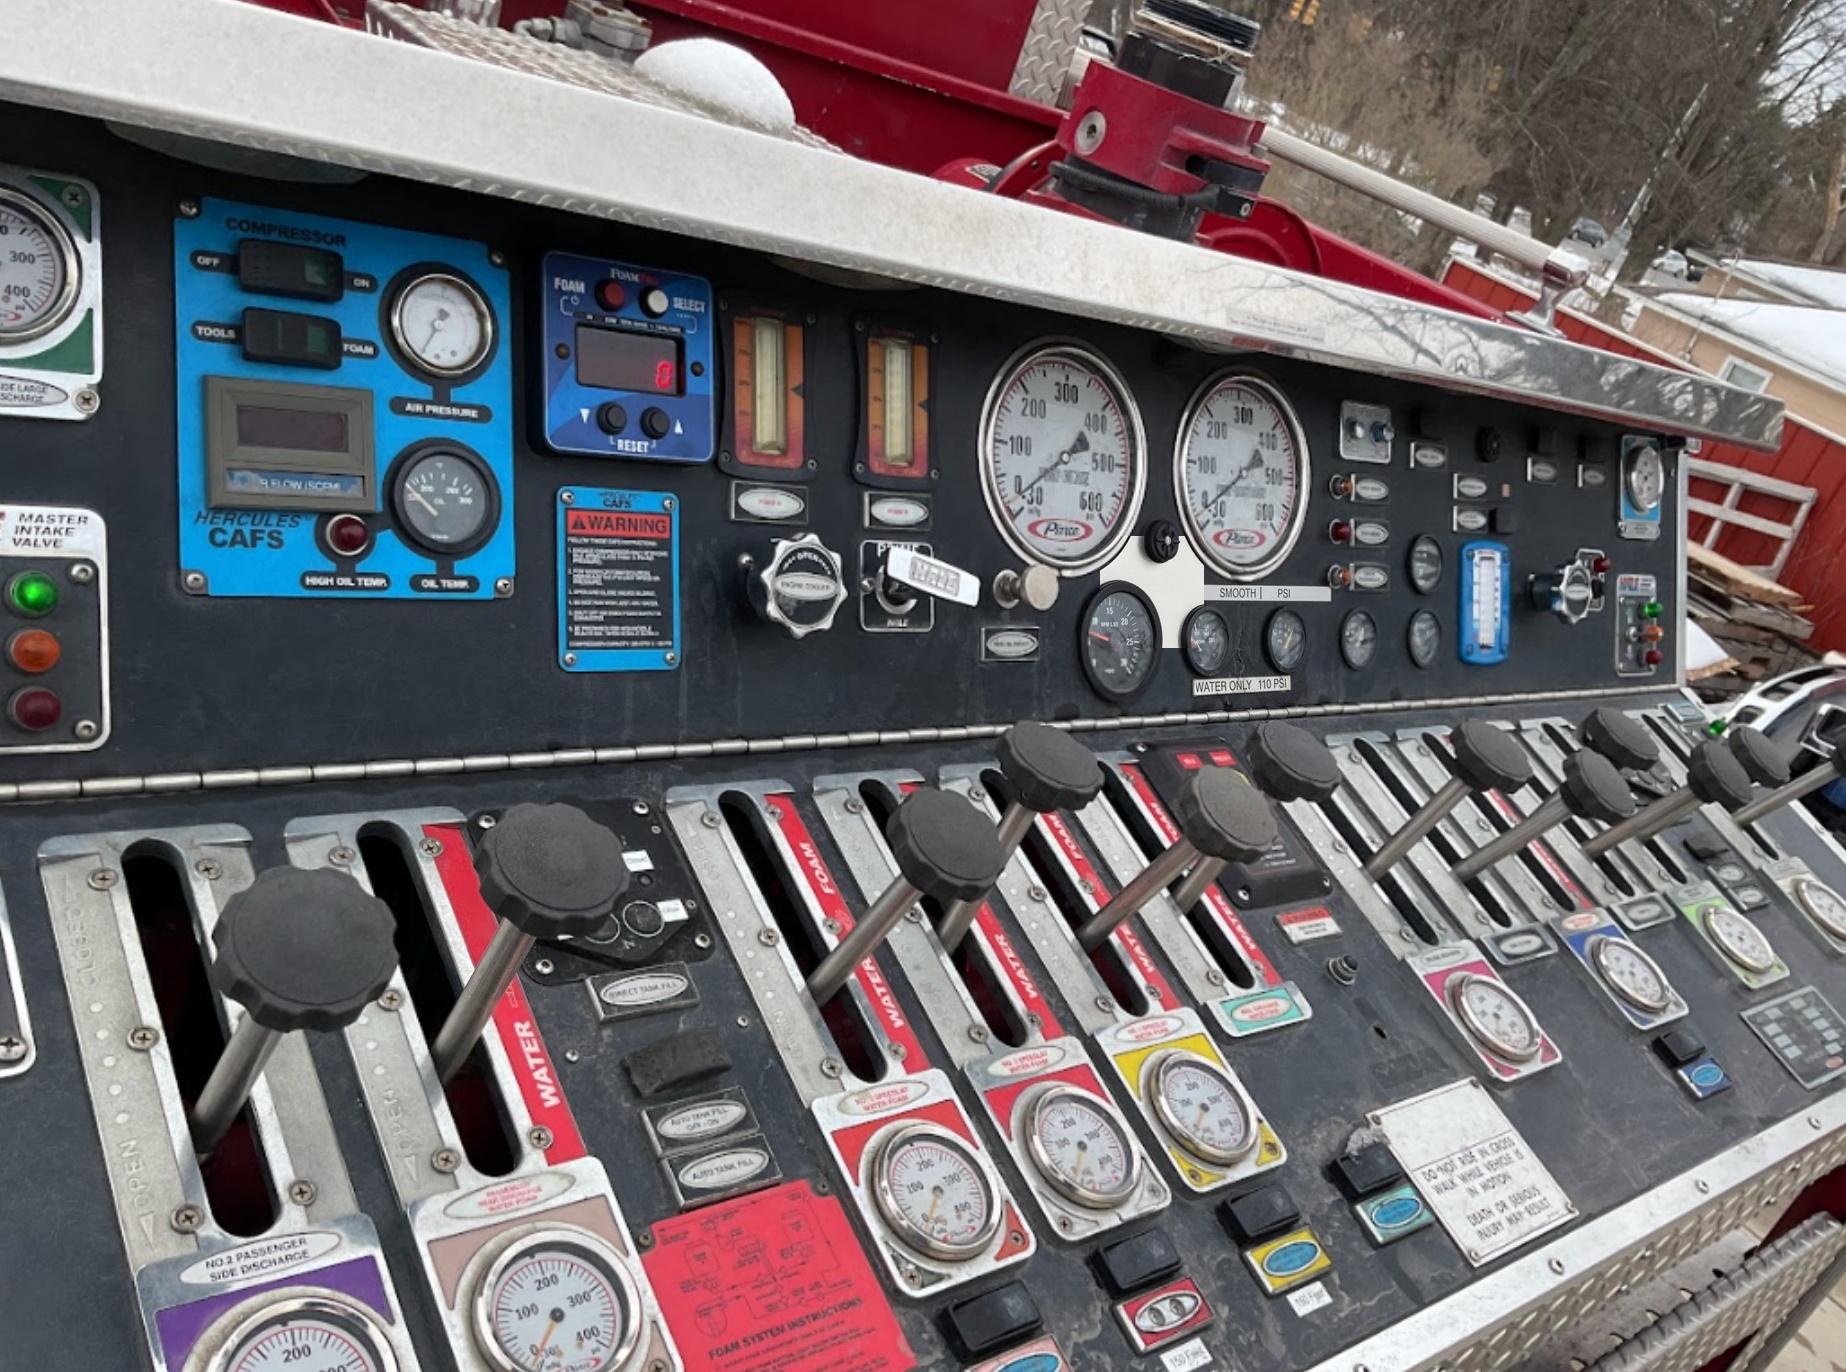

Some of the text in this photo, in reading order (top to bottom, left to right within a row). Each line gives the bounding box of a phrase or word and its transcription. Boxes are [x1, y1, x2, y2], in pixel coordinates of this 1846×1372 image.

[225, 217, 346, 247] COMPRESSOR
[9, 250, 36, 264] 300
[196, 255, 220, 267] OFF
[4, 284, 31, 298] 400
[353, 277, 371, 288] ON
[554, 277, 585, 293] FOAM
[673, 297, 705, 312] SELECT
[195, 326, 236, 339] TOOLS
[655, 360, 673, 389] 0
[1054, 382, 1079, 404] 300
[405, 401, 479, 418] AIR PRESSURE
[1021, 398, 1047, 419] 200
[1233, 406, 1253, 425] 300
[1084, 412, 1107, 434] 400
[1206, 421, 1228, 440] 200
[617, 439, 649, 453] RESET
[1008, 436, 1032, 456] 100
[1258, 432, 1278, 451] 400
[1091, 453, 1114, 473] 500
[1197, 456, 1217, 474] 100
[1014, 475, 1022, 495] 0
[1265, 468, 1283, 486] 500
[602, 498, 632, 509] CAFS
[1079, 492, 1103, 513] 600
[1255, 503, 1275, 521] 600
[18, 513, 89, 525] MASTER
[587, 514, 668, 534] WARNING
[14, 525, 77, 537] INTAKE
[208, 527, 285, 549] CAFS
[12, 537, 64, 549] VALVE
[305, 576, 335, 587] HIGH
[336, 576, 355, 587] OIL
[421, 579, 437, 589] OIL
[1219, 587, 1291, 599] SMOOTH PSI
[1106, 607, 1114, 615] 15
[1120, 618, 1129, 627] 20
[1126, 638, 1134, 646] 25
[1195, 678, 1287, 693] WATER ONLY 110 PSI
[1049, 813, 1084, 861] FOAM
[798, 841, 835, 896] FOAM
[1213, 894, 1256, 950] WATER
[994, 933, 1038, 999] WATER
[861, 956, 905, 1030] WATER
[514, 1020, 561, 1109] WATER
[693, 1158, 754, 1180] AUTO TANK FILL
[916, 1158, 935, 1173] 200
[1422, 1136, 1516, 1183] DO NOT RIDE IN CROSS
[119, 1138, 154, 1205] OPEN
[1432, 1148, 1525, 1195] WALK WHILE VEHICLE IS
[906, 1180, 924, 1195] 100
[1466, 1172, 1512, 1198] IN MOTION
[1466, 1184, 1541, 1226] DEATH OR SERIOUS
[1477, 1195, 1551, 1240] INJURY MAY RESULT
[236, 1237, 307, 1260] PASSENGER
[209, 1248, 310, 1282] SIDE DISCHARGE
[534, 1273, 560, 1291] 200
[565, 1290, 592, 1308] 300
[515, 1302, 540, 1321] 100
[575, 1325, 601, 1344] 400
[708, 1340, 740, 1361] FOAM
[742, 1323, 786, 1347] SYSTEM
[787, 1296, 863, 1331] INSTRUCTIONS
[282, 1343, 312, 1363] 200
[529, 1343, 539, 1356] 0
